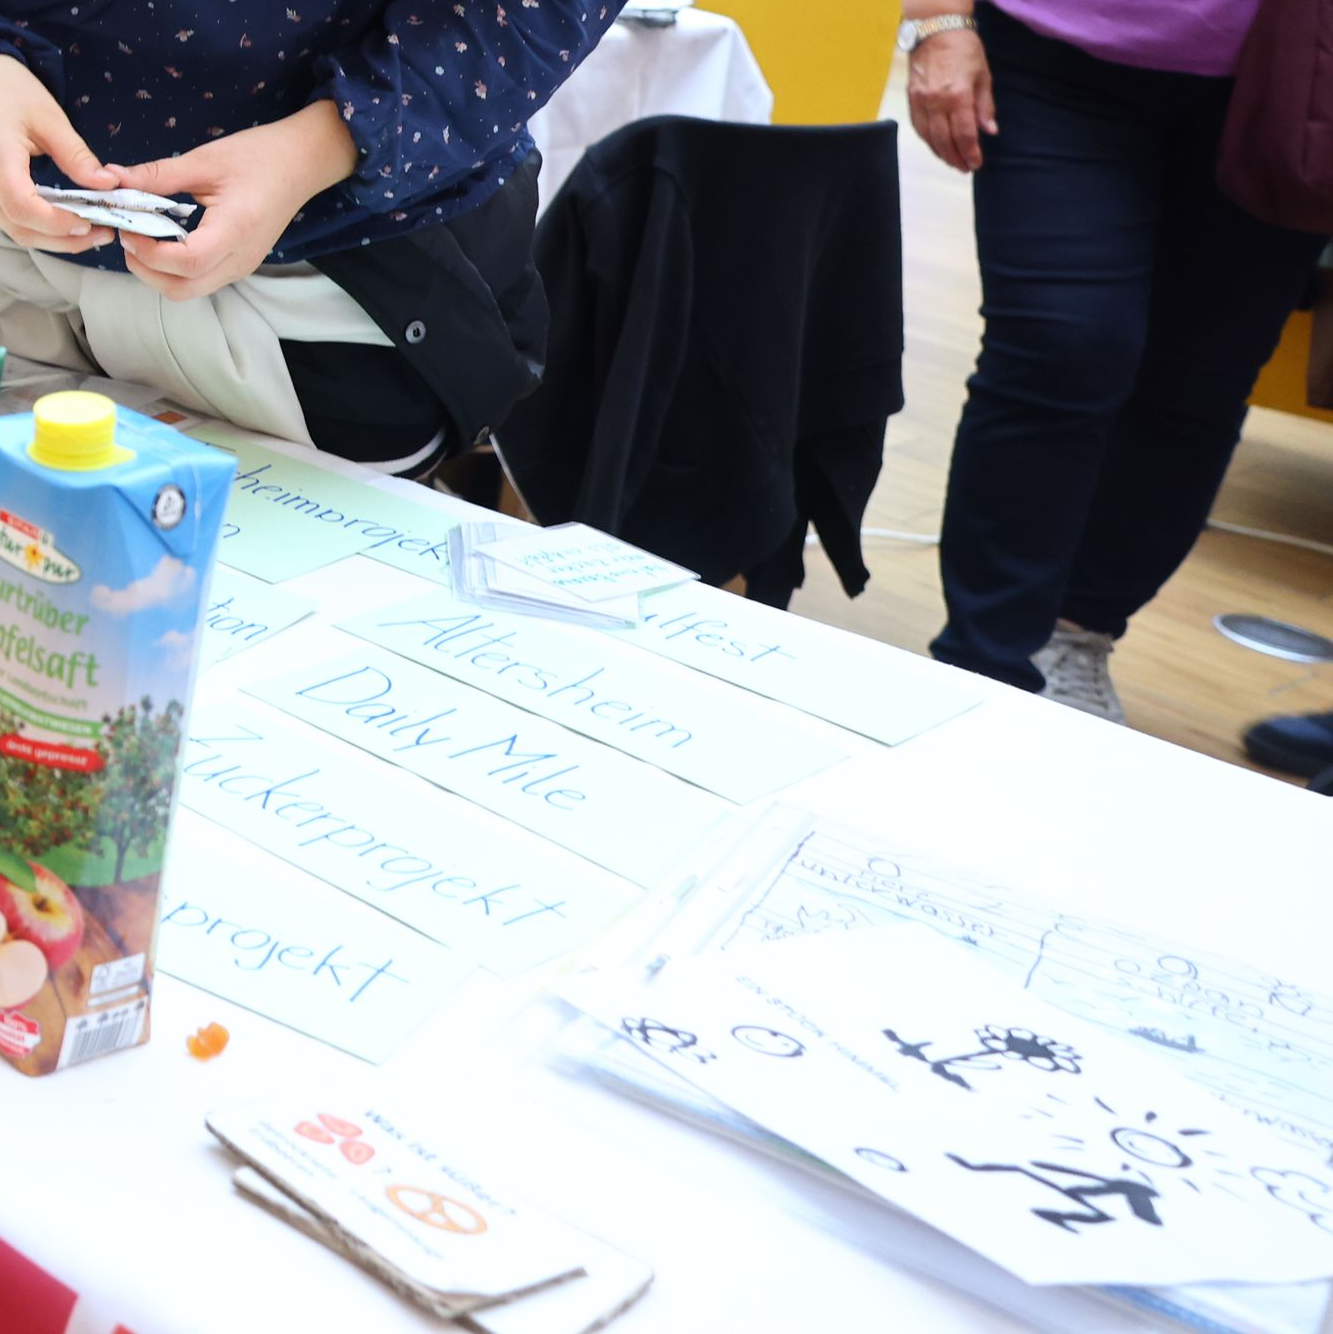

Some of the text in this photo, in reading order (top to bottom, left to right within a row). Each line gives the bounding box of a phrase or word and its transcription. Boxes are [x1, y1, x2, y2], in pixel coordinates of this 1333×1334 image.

[294, 664, 588, 813] Daily Mile
[376, 612, 694, 751] Altersheim
[181, 722, 567, 927] Zuckerprojekt
[160, 895, 411, 1003] projekt
